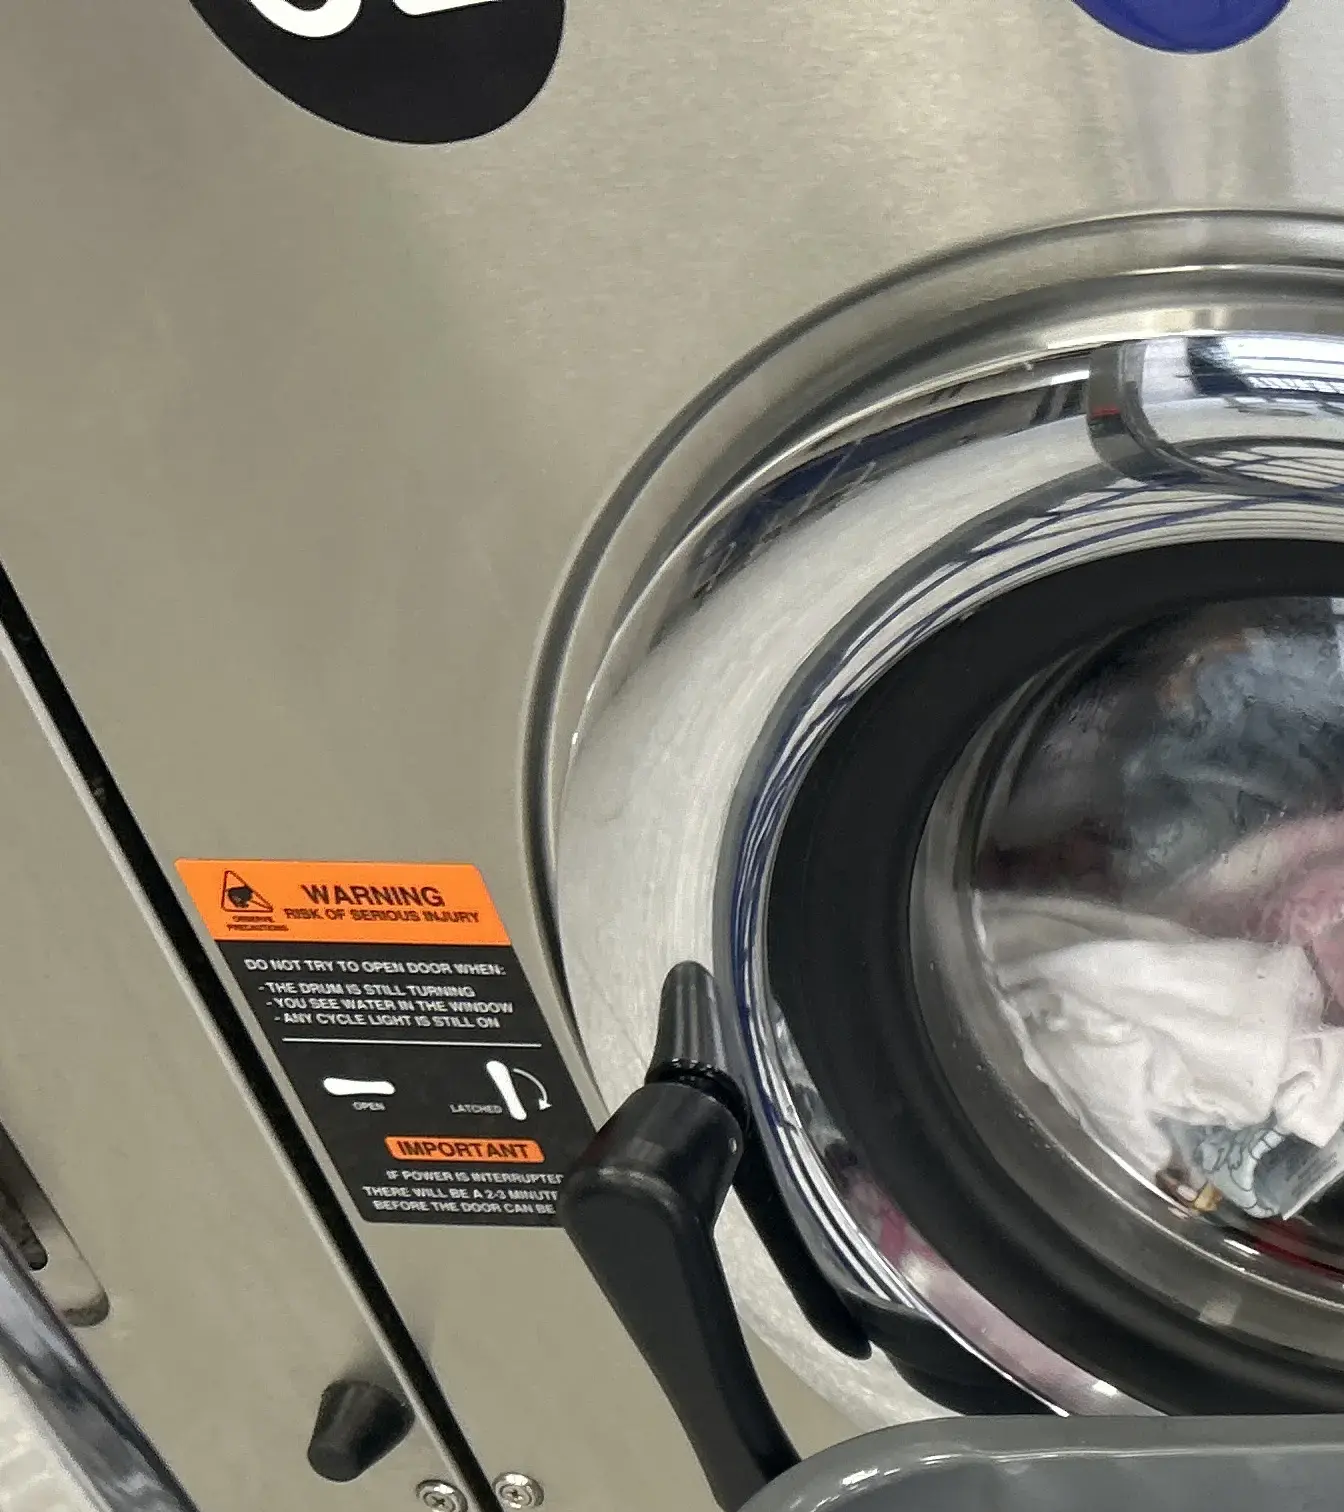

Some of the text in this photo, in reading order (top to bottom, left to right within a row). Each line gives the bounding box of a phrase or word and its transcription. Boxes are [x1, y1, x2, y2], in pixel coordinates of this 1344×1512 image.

[301, 884, 446, 908] WARNING
[284, 908, 324, 920] RISK
[325, 908, 346, 921] OF
[351, 909, 420, 922] SERIOUS
[423, 911, 480, 923] INJURY
[243, 958, 507, 976] DO NOT TRY TO OPEN DOOR WHEN:
[265, 981, 298, 994] THE
[298, 982, 344, 994] DRUM
[345, 983, 362, 995] IS
[363, 984, 407, 996] STILL
[405, 985, 476, 998] TURNING
[273, 997, 308, 1009] YOU
[308, 998, 341, 1010] SEE
[340, 999, 397, 1011] WATER
[397, 1000, 415, 1011] IN
[415, 1001, 449, 1012] THE
[448, 1001, 514, 1014] WINDOW
[284, 1012, 313, 1024] ANY
[315, 1012, 368, 1026] CYCLE
[367, 1014, 412, 1026] LIGHT
[413, 1015, 432, 1027] IS
[431, 1015, 476, 1028] STILL
[475, 1016, 501, 1029] ON
[352, 1101, 386, 1112] OPEN
[450, 1103, 503, 1115] LATCHED
[397, 1140, 528, 1160] IMPORTANT
[386, 1169, 400, 1180] IF
[401, 1170, 454, 1182] POWER
[454, 1172, 471, 1183] IS
[362, 1185, 412, 1198] THERE
[411, 1187, 450, 1199] WILL
[449, 1188, 470, 1200] BE
[472, 1189, 484, 1199] A
[484, 1189, 507, 1201] 2-3
[371, 1199, 557, 1216] BEFORE THE DOOR CAN BE
